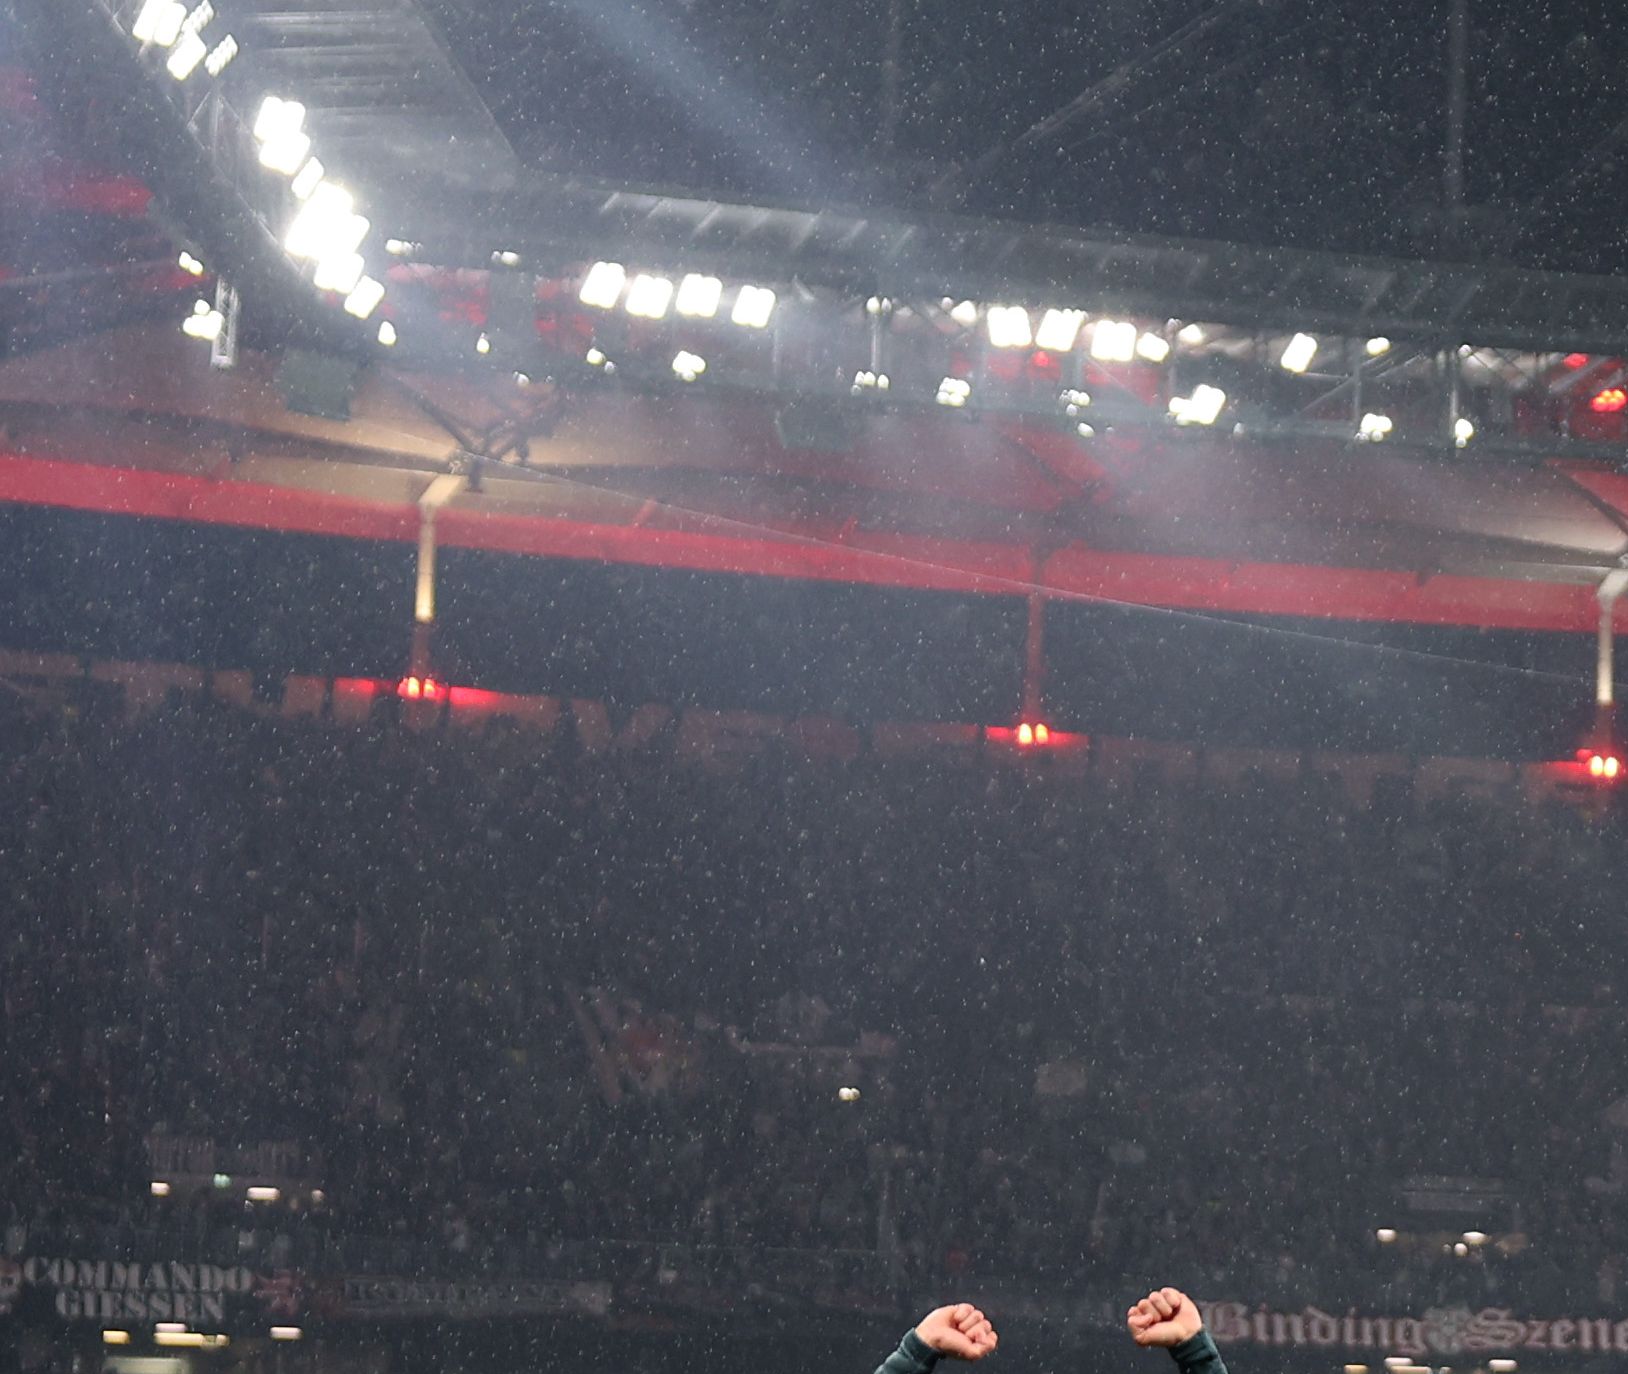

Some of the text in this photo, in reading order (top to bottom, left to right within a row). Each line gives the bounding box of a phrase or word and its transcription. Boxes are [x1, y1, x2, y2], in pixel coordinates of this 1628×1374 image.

[23, 1257, 253, 1292] COMMANDO
[55, 1287, 225, 1323] GIESSEN
[1202, 1300, 1425, 1355] Binding
